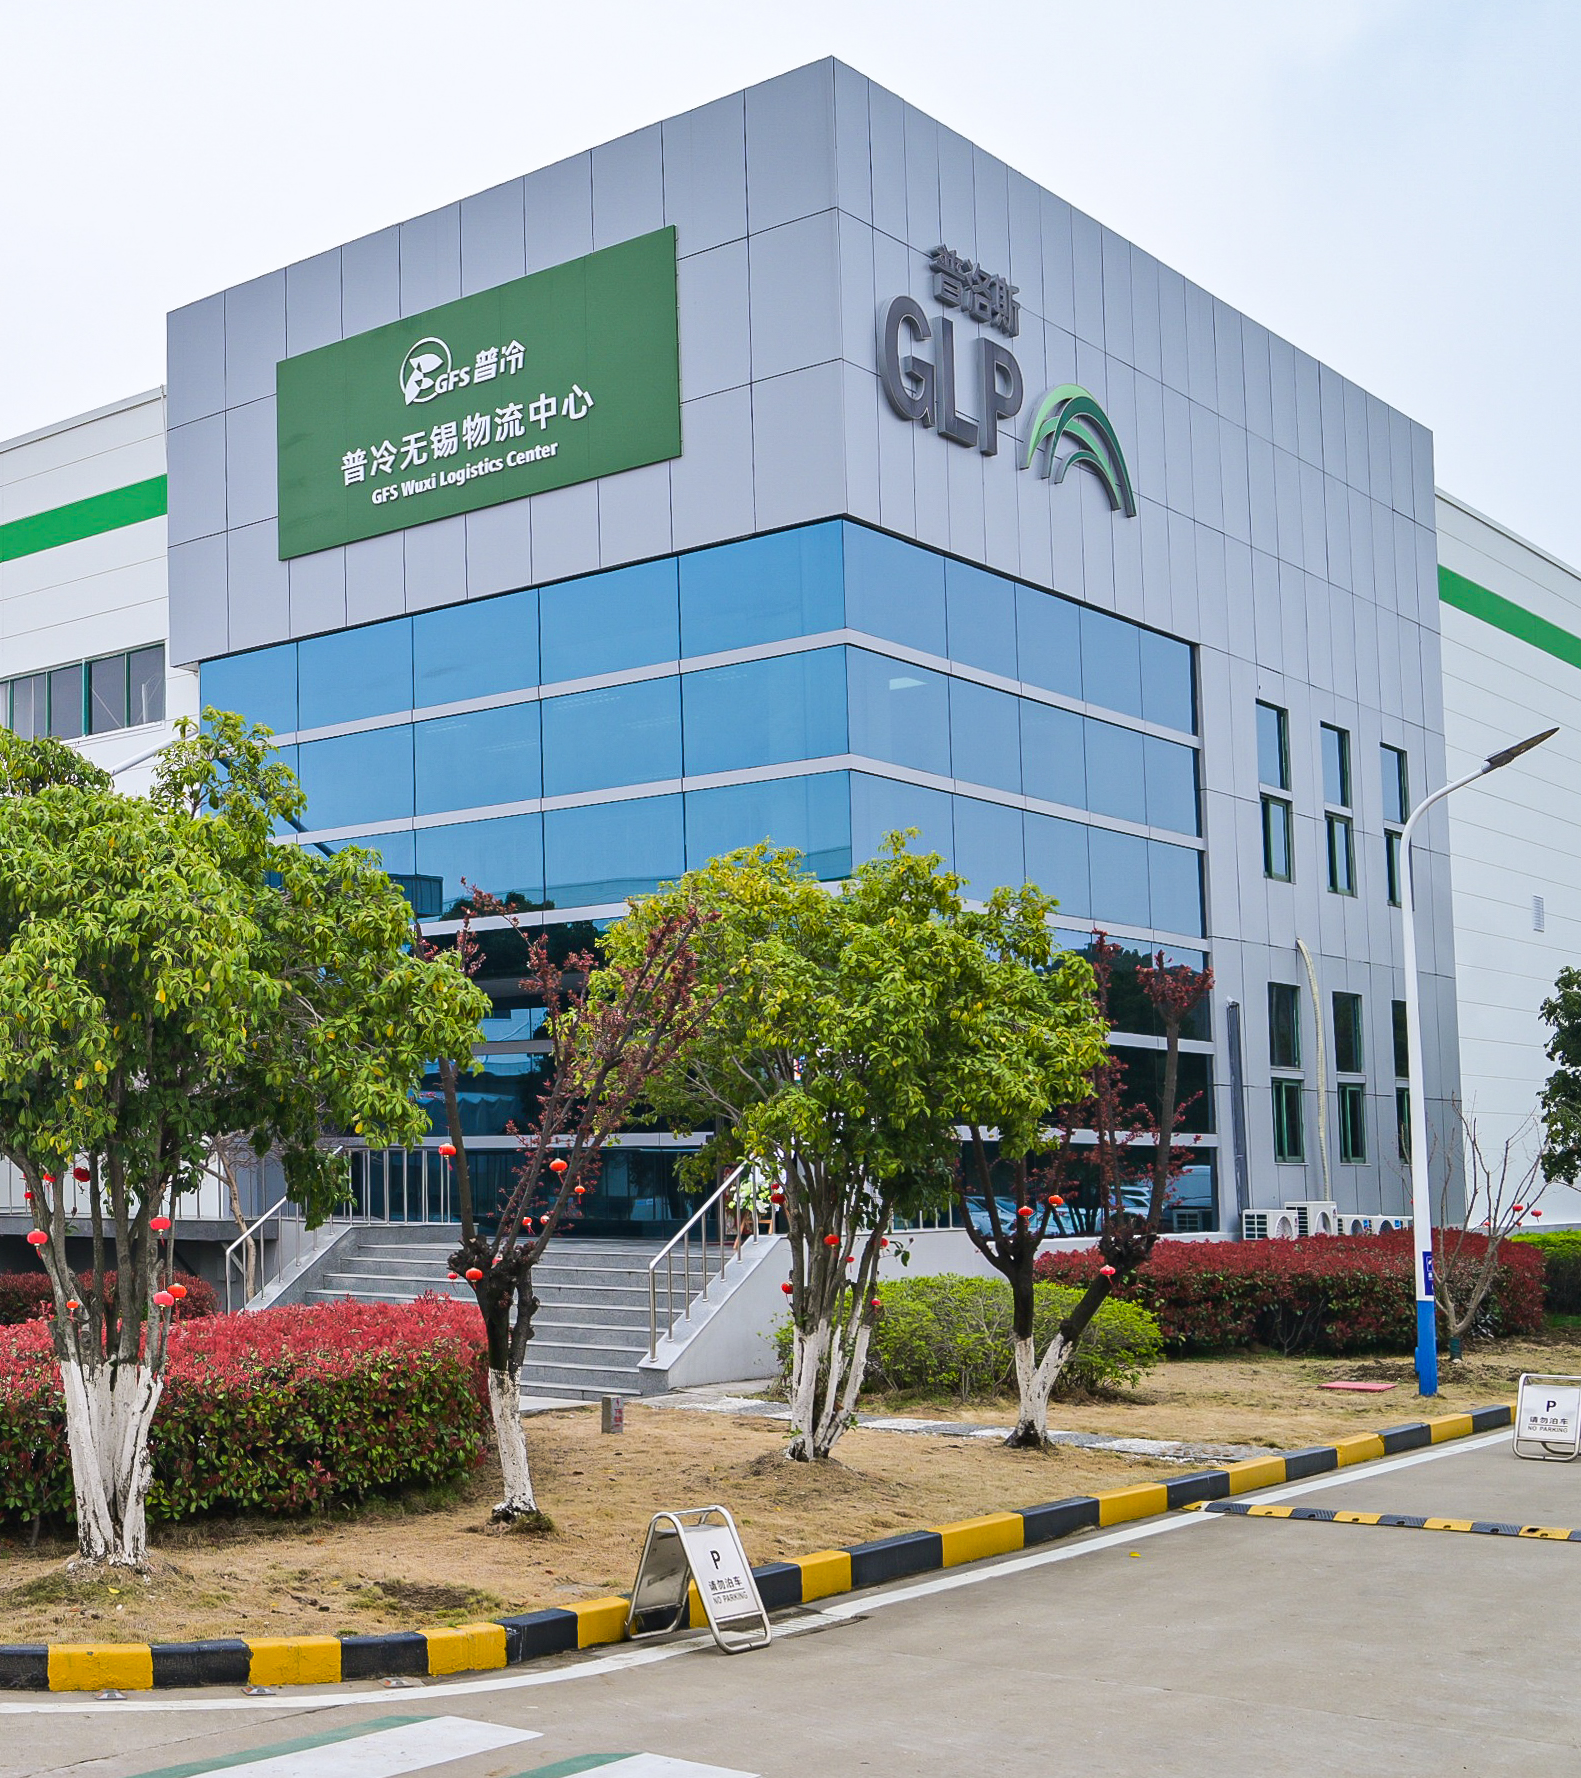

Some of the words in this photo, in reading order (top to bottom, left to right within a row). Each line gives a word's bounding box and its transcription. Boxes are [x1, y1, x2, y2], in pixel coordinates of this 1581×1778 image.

[929, 244, 1020, 338] 普洛斯
[434, 366, 471, 396] GFS
[473, 339, 526, 385] 普冷
[879, 295, 1024, 457] GLP
[340, 383, 595, 487] 普冷无锡物流中心
[371, 482, 399, 505] GFS
[401, 472, 437, 497] Wuxi
[438, 456, 505, 487] Logistics
[506, 441, 559, 468] Center
[1530, 1416, 1568, 1425] 请勿泊车
[1546, 1400, 1556, 1412] P
[710, 1550, 720, 1569] P
[708, 1576, 742, 1591] 请勿泊车
[713, 1596, 722, 1605] NO
[723, 1592, 748, 1602] PARKING
